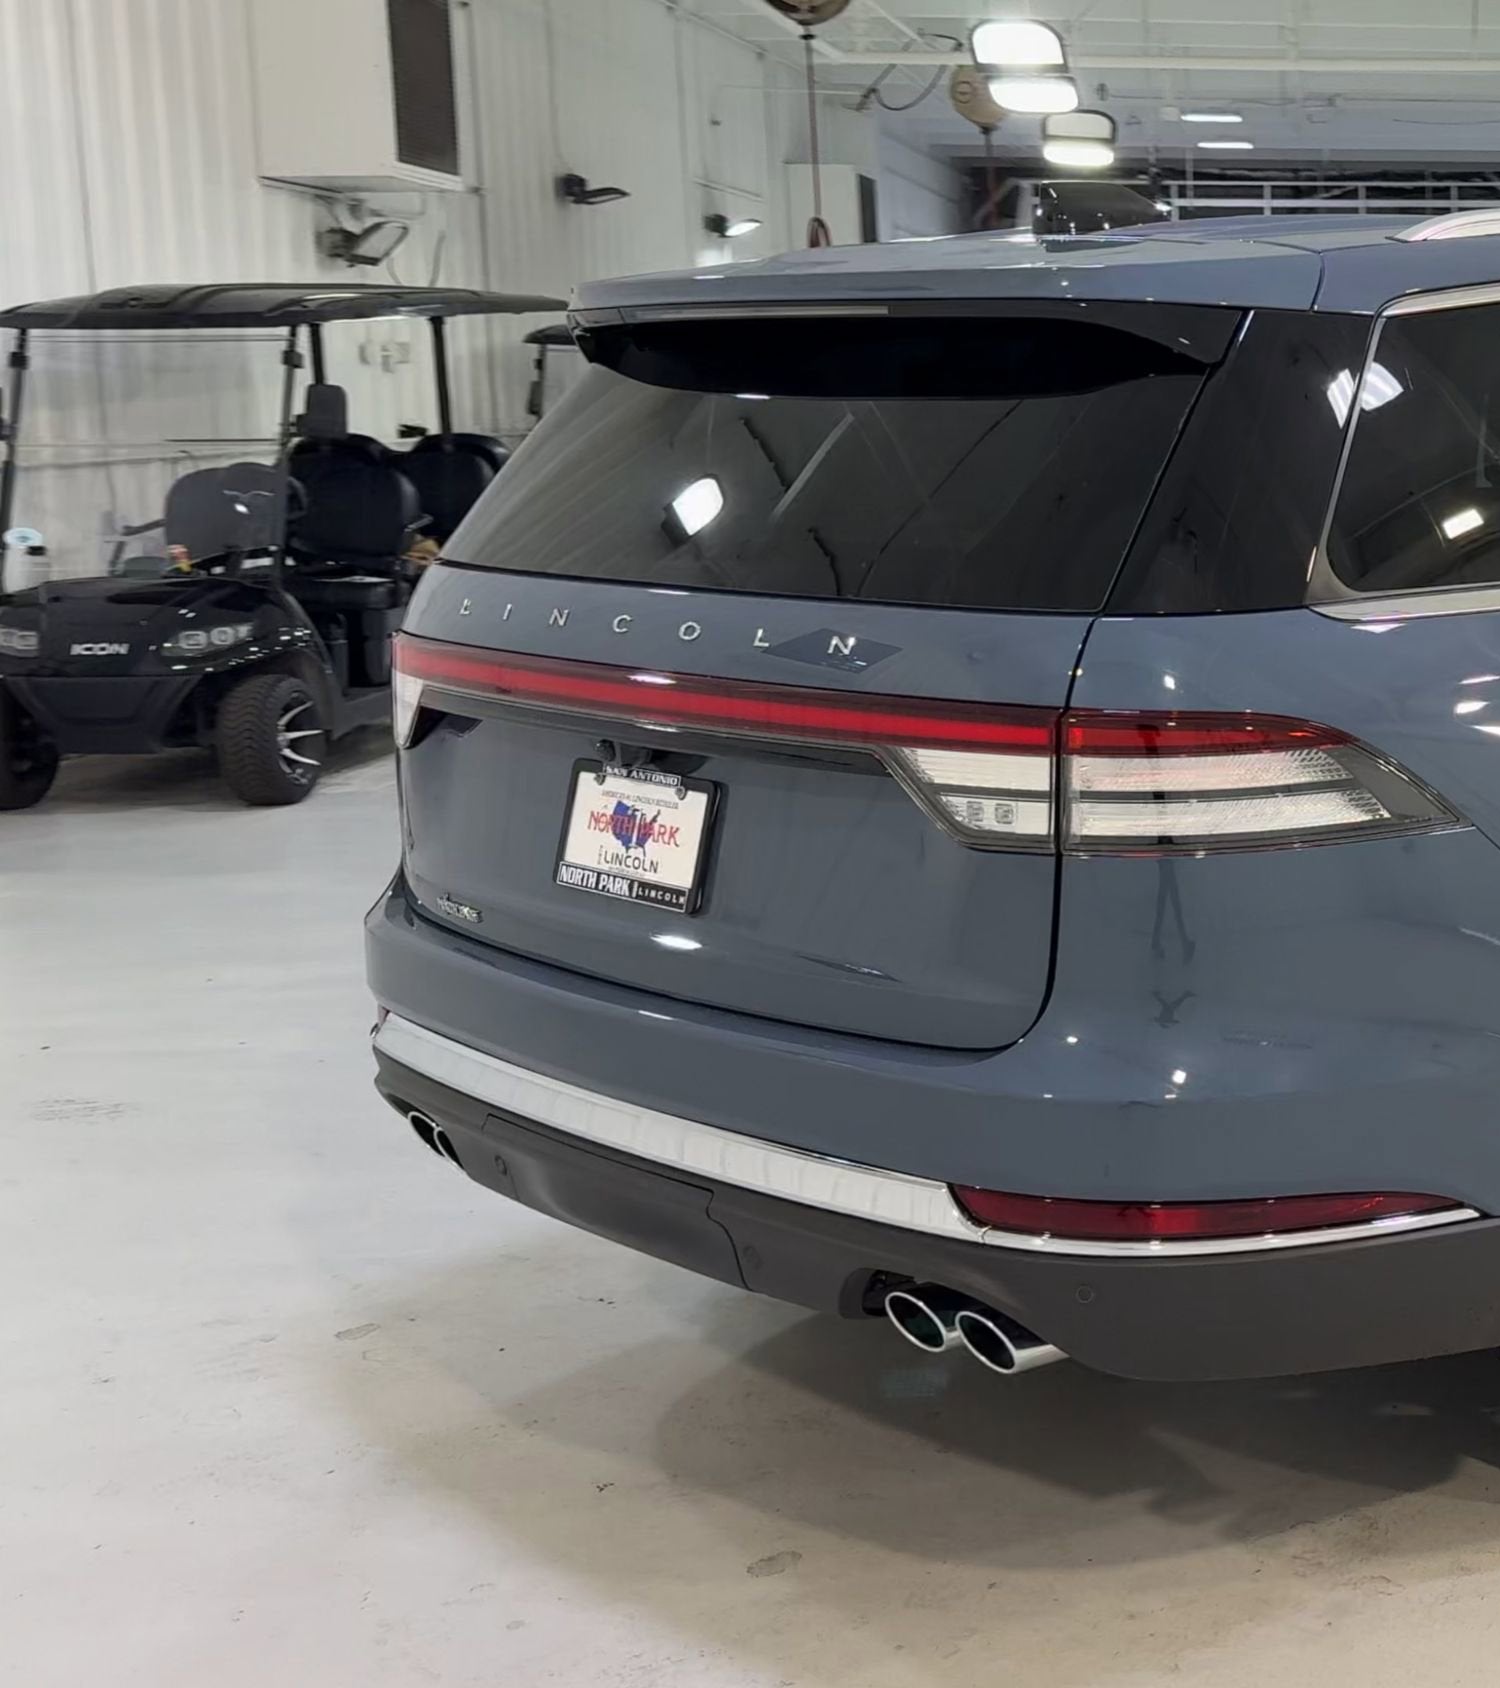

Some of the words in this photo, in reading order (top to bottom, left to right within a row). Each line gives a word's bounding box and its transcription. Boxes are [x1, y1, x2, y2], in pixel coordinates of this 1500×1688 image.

[459, 599, 857, 656] LINCOLN
[70, 642, 130, 656] ICON
[605, 765, 628, 776] SAN
[631, 769, 678, 786] ANTONIO
[587, 810, 634, 837] NORTH
[603, 850, 659, 874] LINCOLN
[560, 865, 597, 888] NORTH
[599, 874, 630, 897] PARK
[638, 886, 685, 904] LINCOLN
